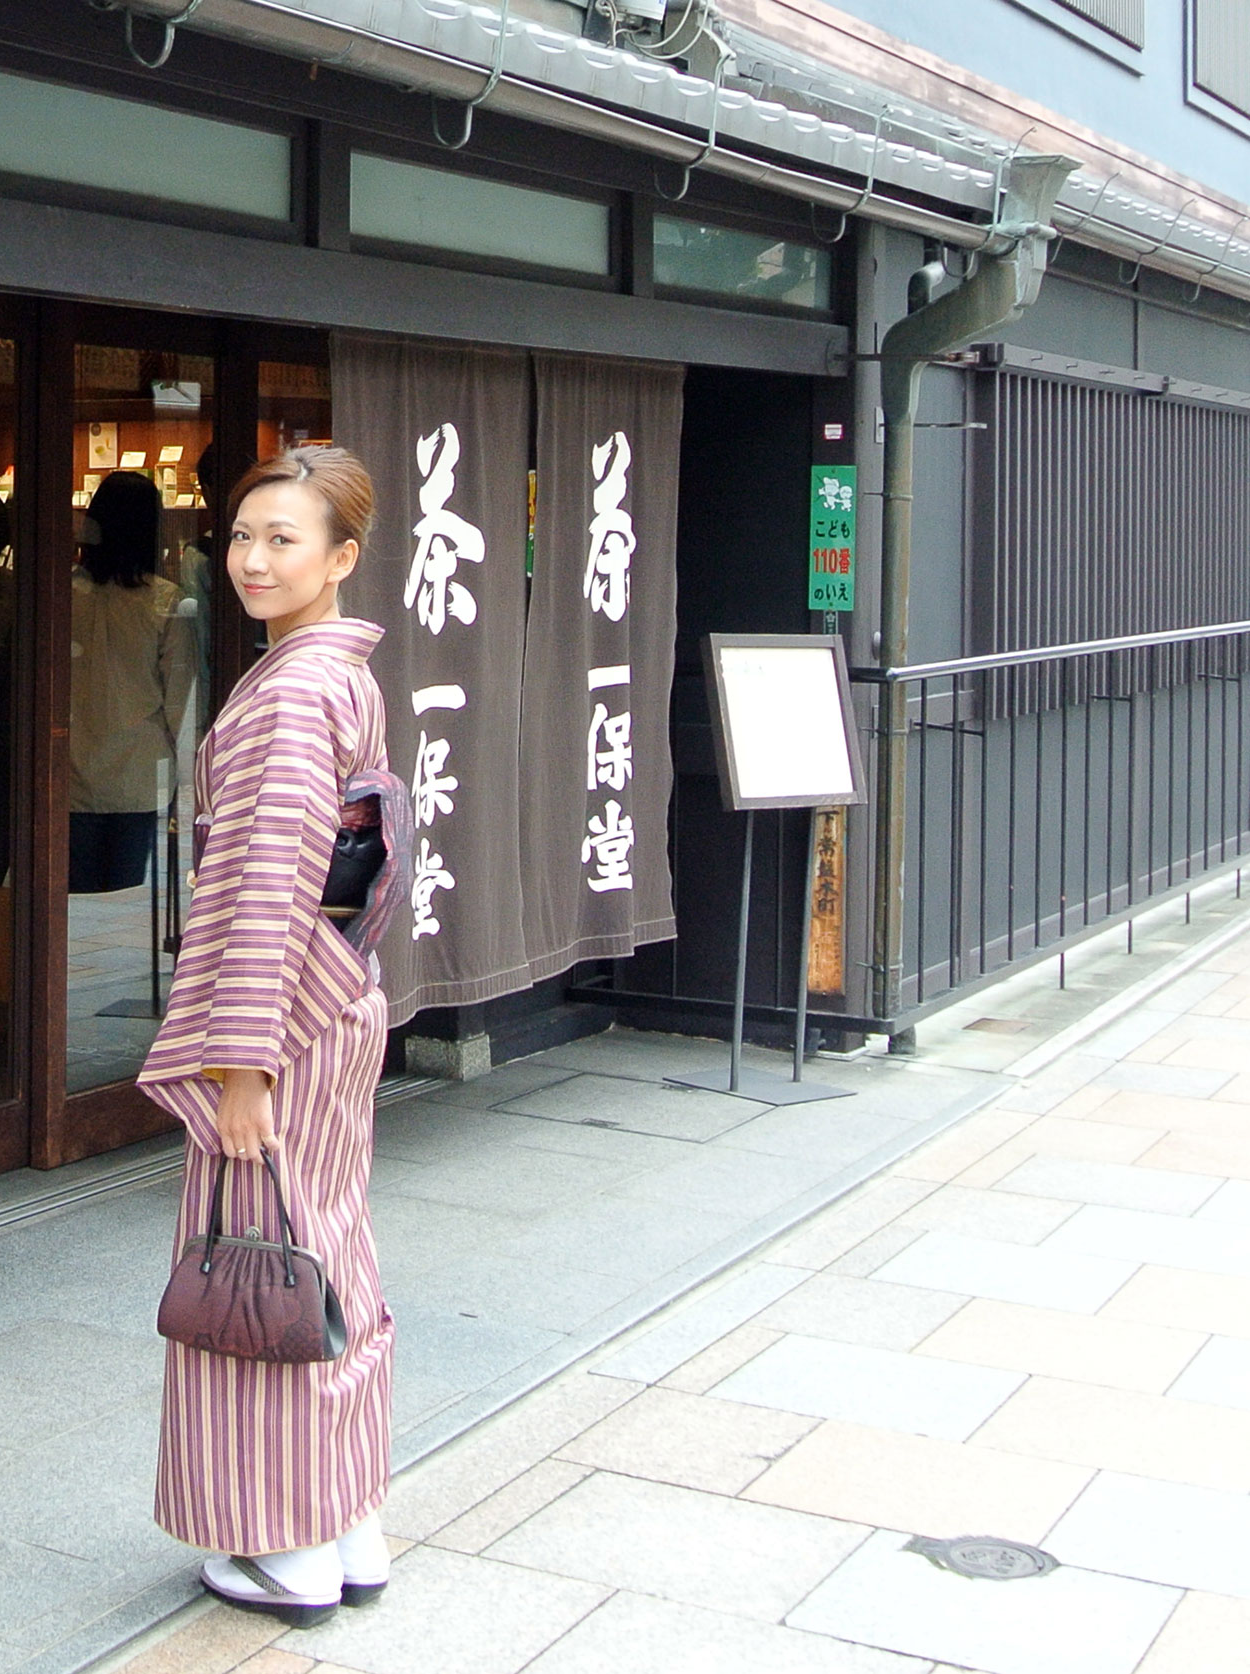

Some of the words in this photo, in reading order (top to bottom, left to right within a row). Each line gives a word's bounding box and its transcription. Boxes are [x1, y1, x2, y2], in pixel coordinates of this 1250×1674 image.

[815, 521, 850, 539] こども
[813, 548, 851, 574] 110番
[814, 584, 848, 601] のいえ
